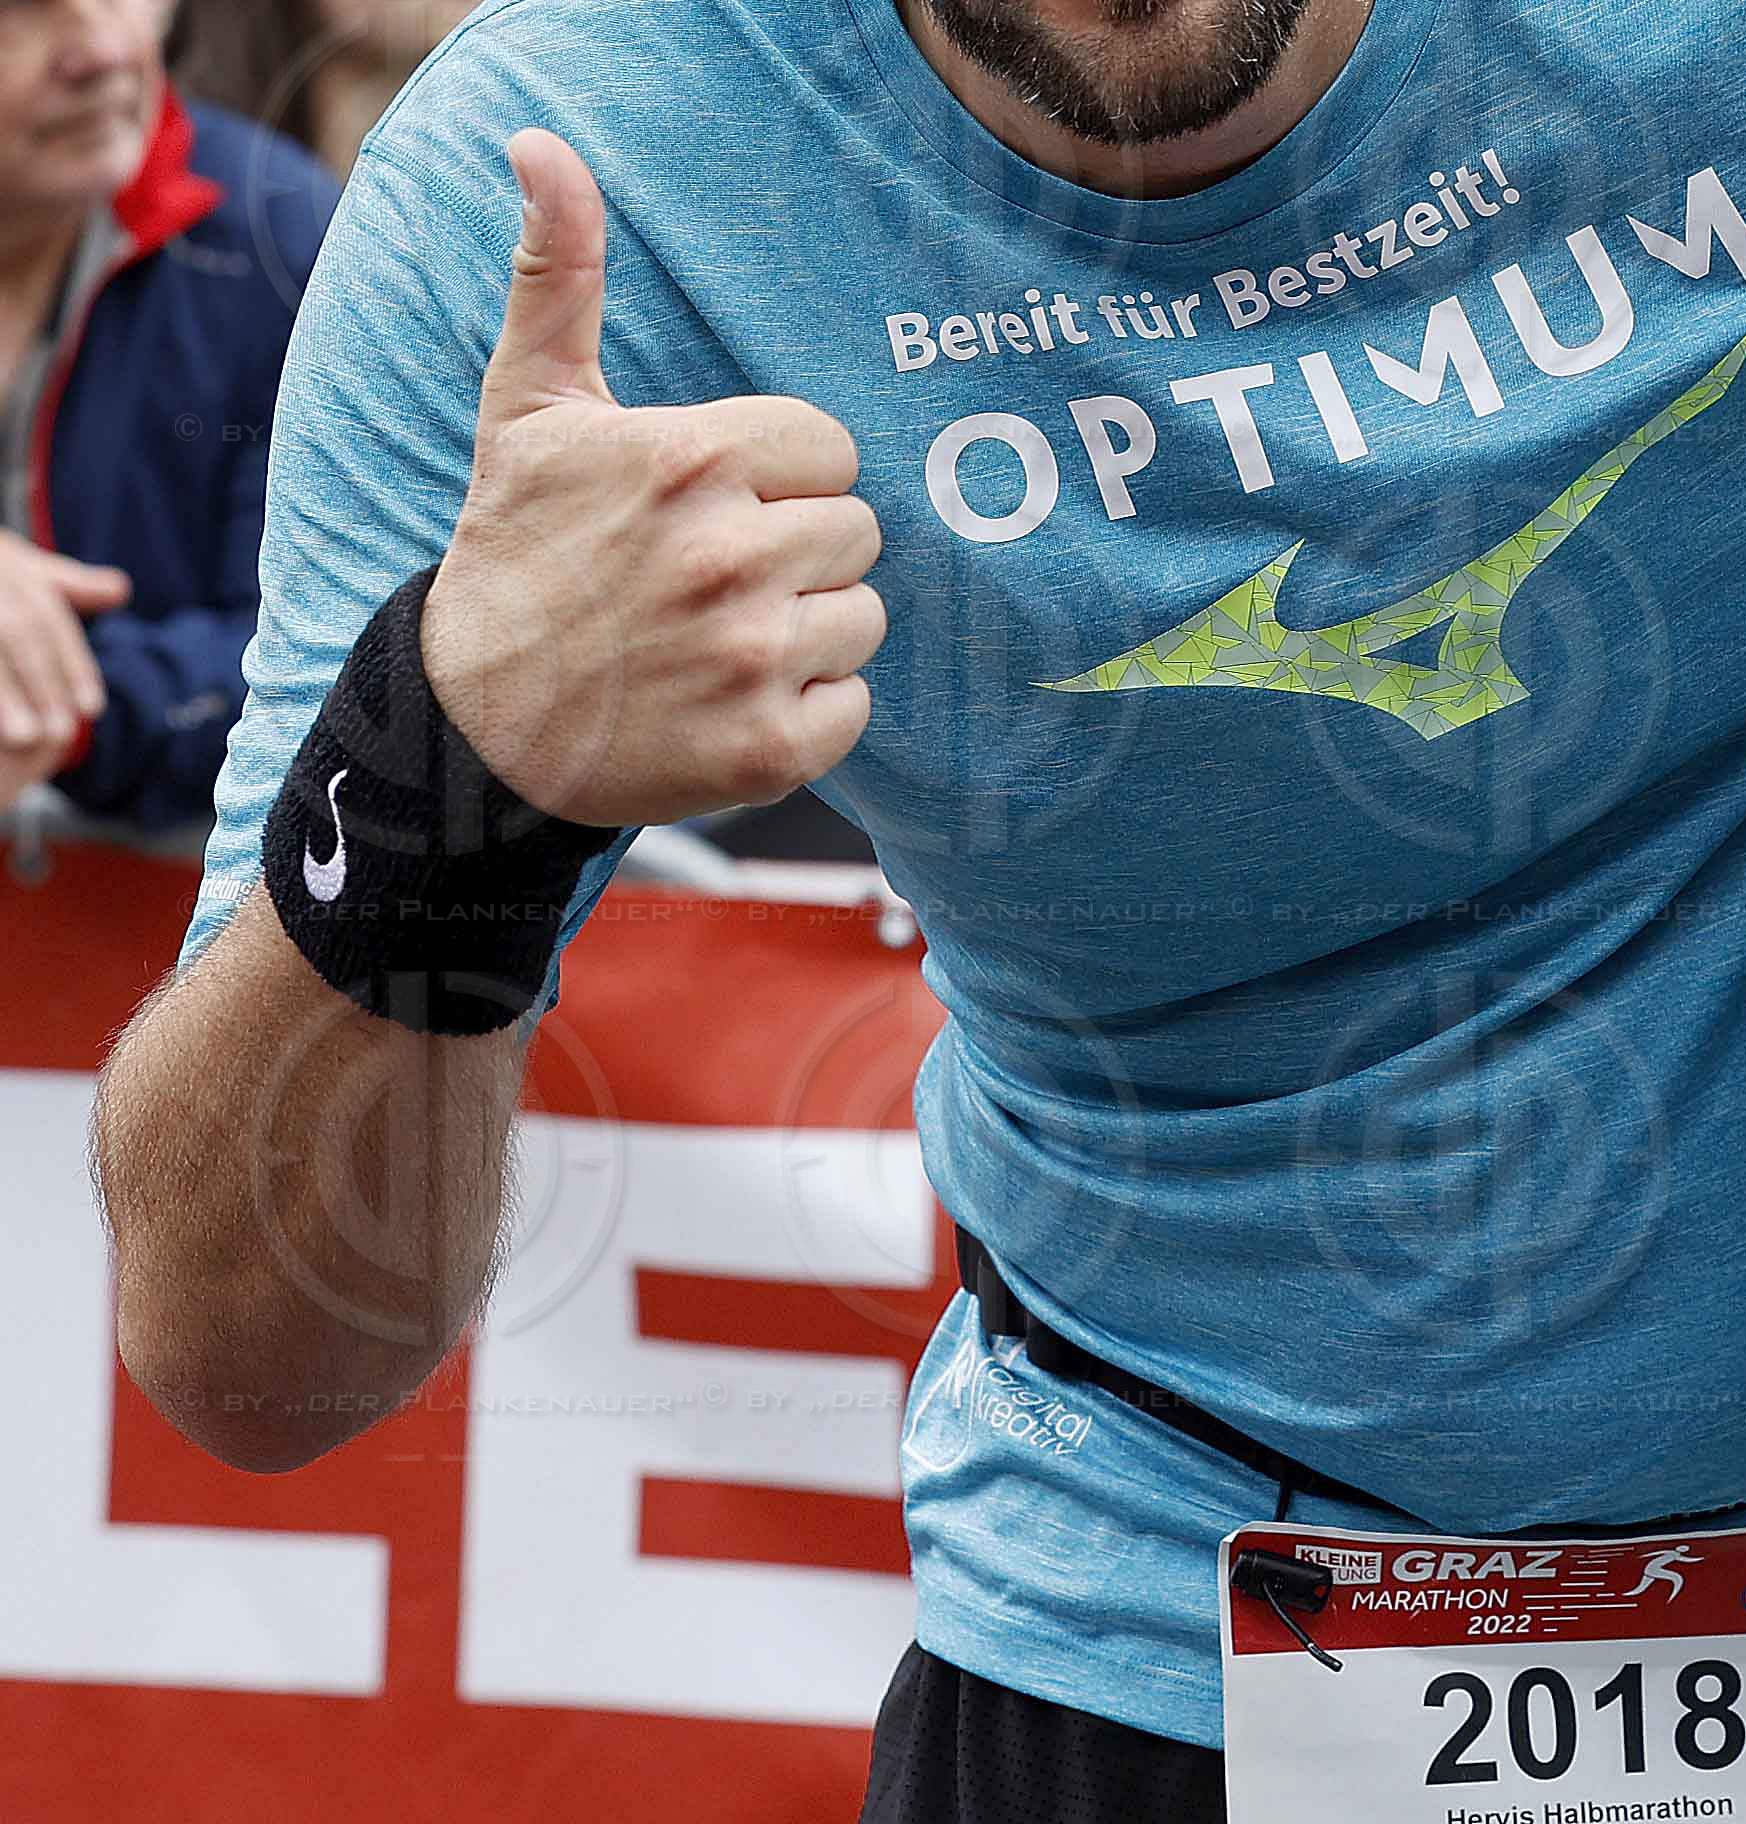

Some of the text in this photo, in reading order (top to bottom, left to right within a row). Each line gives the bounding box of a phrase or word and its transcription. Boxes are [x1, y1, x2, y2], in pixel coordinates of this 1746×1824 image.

[886, 148, 1521, 374] Bereit für Bestzeit!
[1300, 1548, 1563, 1583] KLEINE GRAZ
[1351, 1587, 1510, 1612] MARATHON
[1467, 1614, 1533, 1636] 2022
[1446, 1794, 1734, 1824] Hervis Halbmarathon
